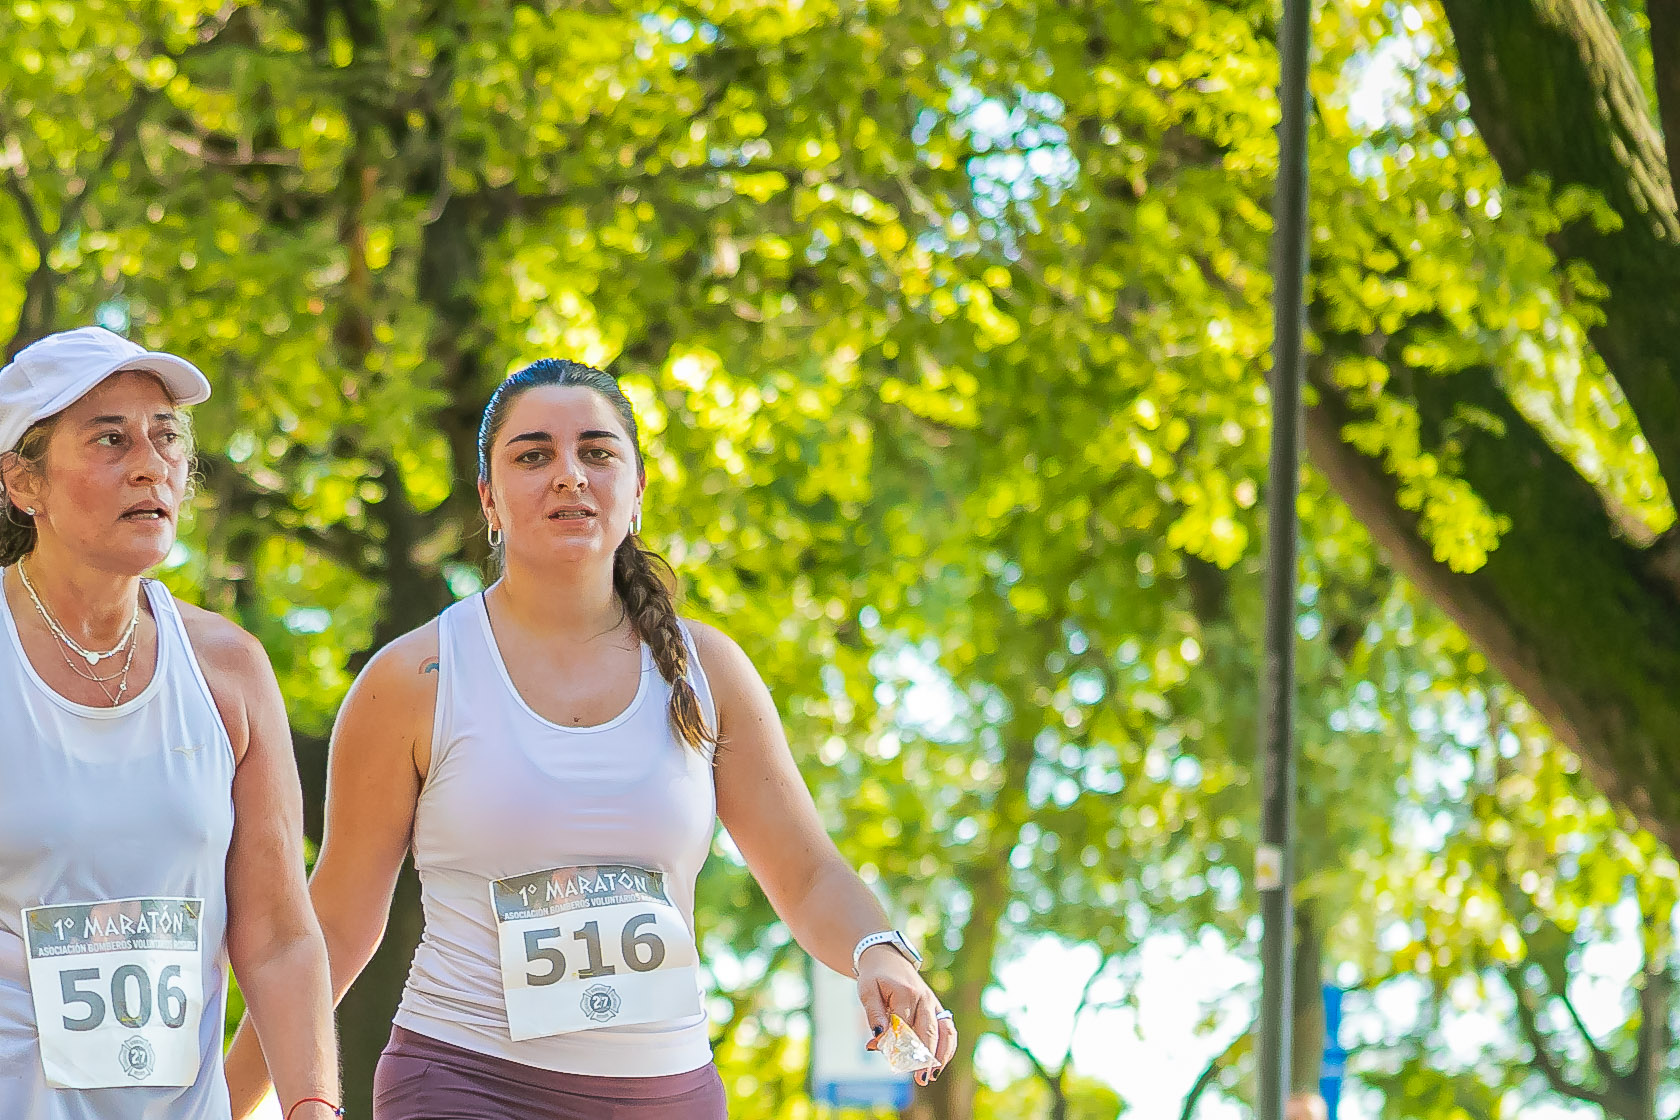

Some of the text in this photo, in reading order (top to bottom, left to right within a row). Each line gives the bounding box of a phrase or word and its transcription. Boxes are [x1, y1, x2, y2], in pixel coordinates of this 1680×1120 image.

[545, 868, 648, 902] MARATÓN
[83, 904, 184, 939] MARATÓN
[504, 906, 549, 921] ASOCIACIÓN
[549, 899, 591, 915] BOMBEROS
[591, 892, 641, 906] VOLUNTARIOS
[38, 941, 87, 957] ASOCIACIÓN
[88, 939, 132, 954] BOMBEROS
[523, 913, 666, 986] 516
[59, 964, 187, 1031] 506
[592, 995, 609, 1010] 27
[130, 1049, 146, 1064] 27
